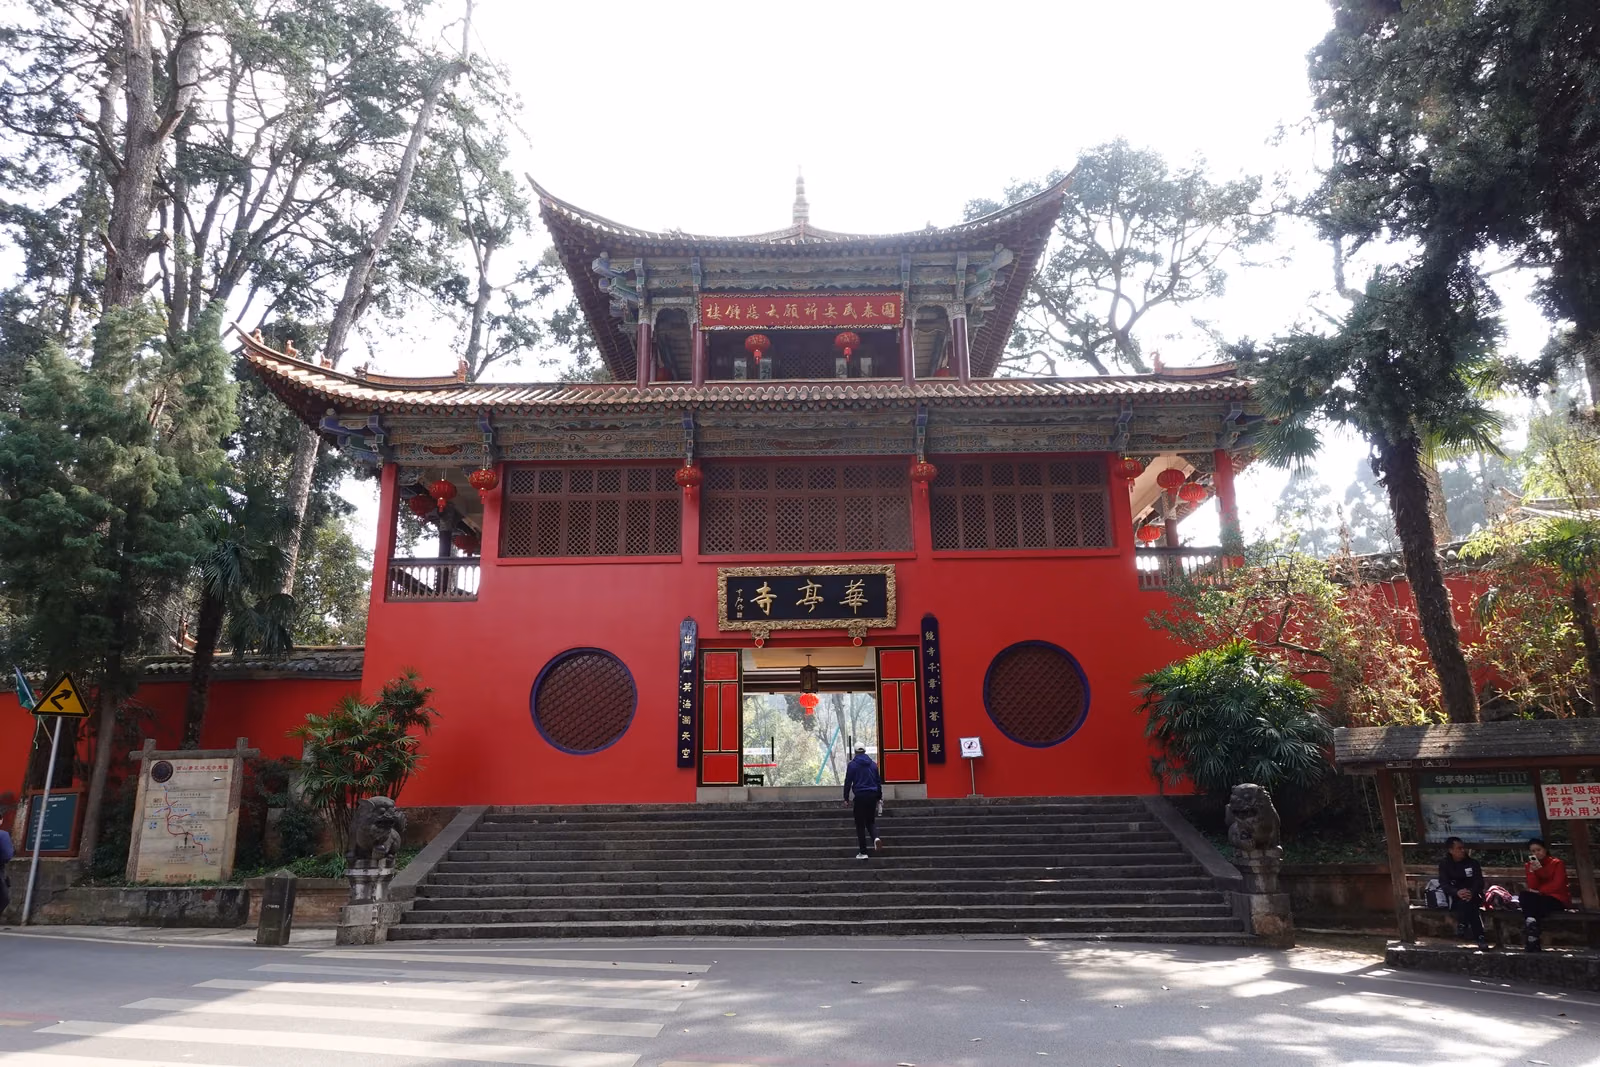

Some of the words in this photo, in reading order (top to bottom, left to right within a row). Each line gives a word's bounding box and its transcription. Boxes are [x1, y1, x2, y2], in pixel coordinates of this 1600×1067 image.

[750, 578, 868, 616] 華亭寺
[1545, 785, 1600, 796] 禁止吸烟
[1547, 795, 1600, 806] 严禁一切
